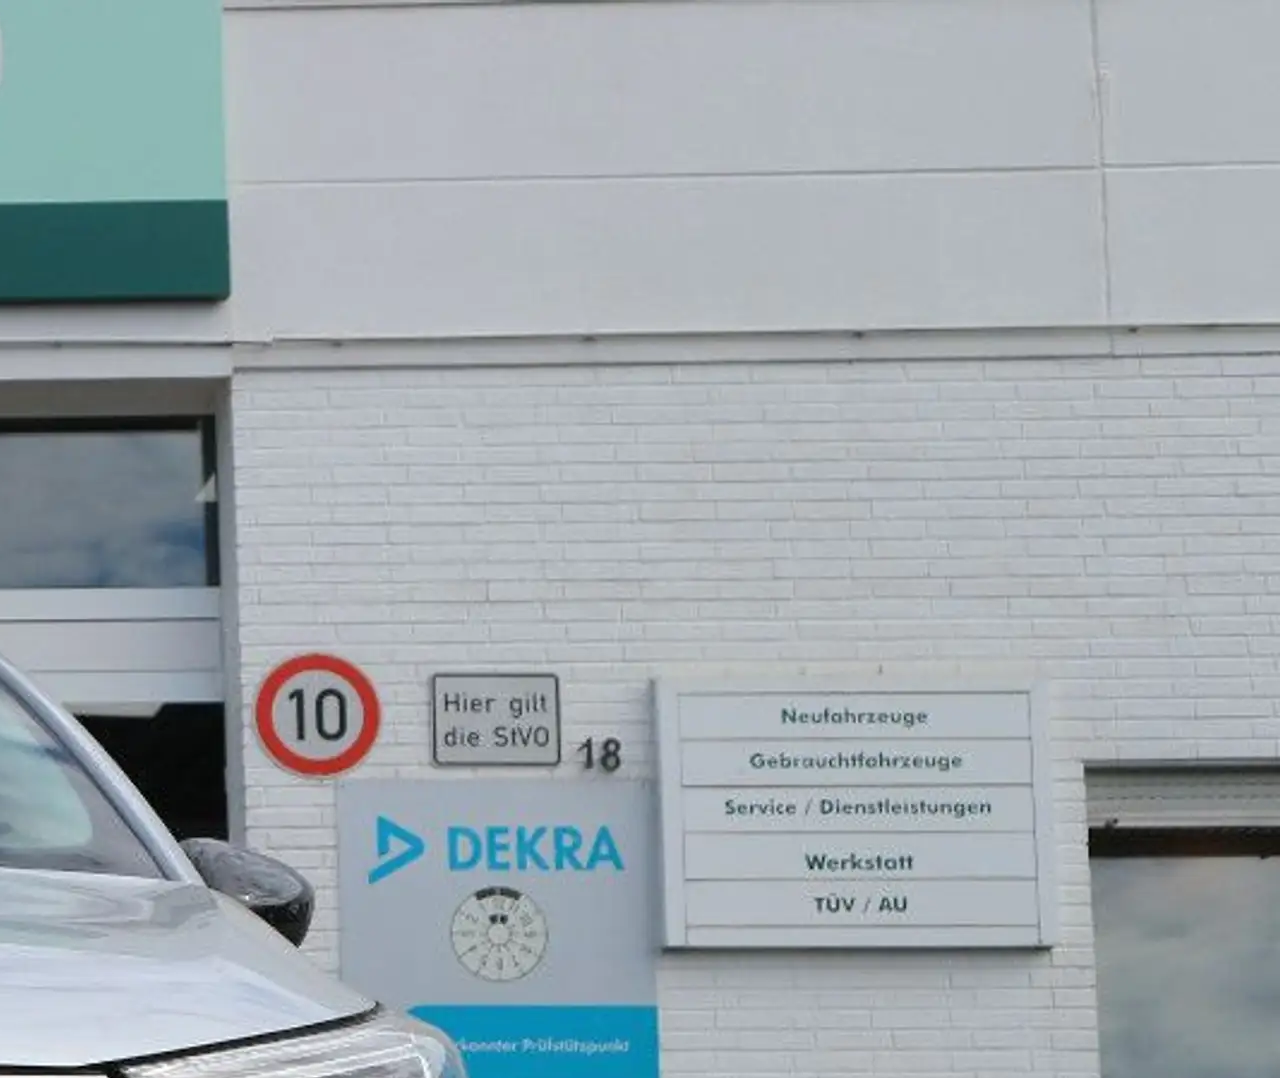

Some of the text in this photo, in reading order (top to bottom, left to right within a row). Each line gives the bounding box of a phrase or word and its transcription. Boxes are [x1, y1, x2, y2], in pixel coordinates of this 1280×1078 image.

[289, 688, 348, 741] 10
[443, 694, 547, 718] Hier gilt
[781, 708, 928, 728] Neufahrzeuge
[444, 728, 550, 748] die StVO
[577, 737, 621, 772] 18
[749, 752, 963, 771] Gebrauchtfahrzeuge
[724, 799, 797, 816] Service
[819, 799, 992, 818] Dienstleistungen
[448, 825, 625, 872] DEKRA
[804, 853, 914, 872] Werkstatt
[813, 894, 856, 913] TÜV
[878, 896, 908, 913] AU
